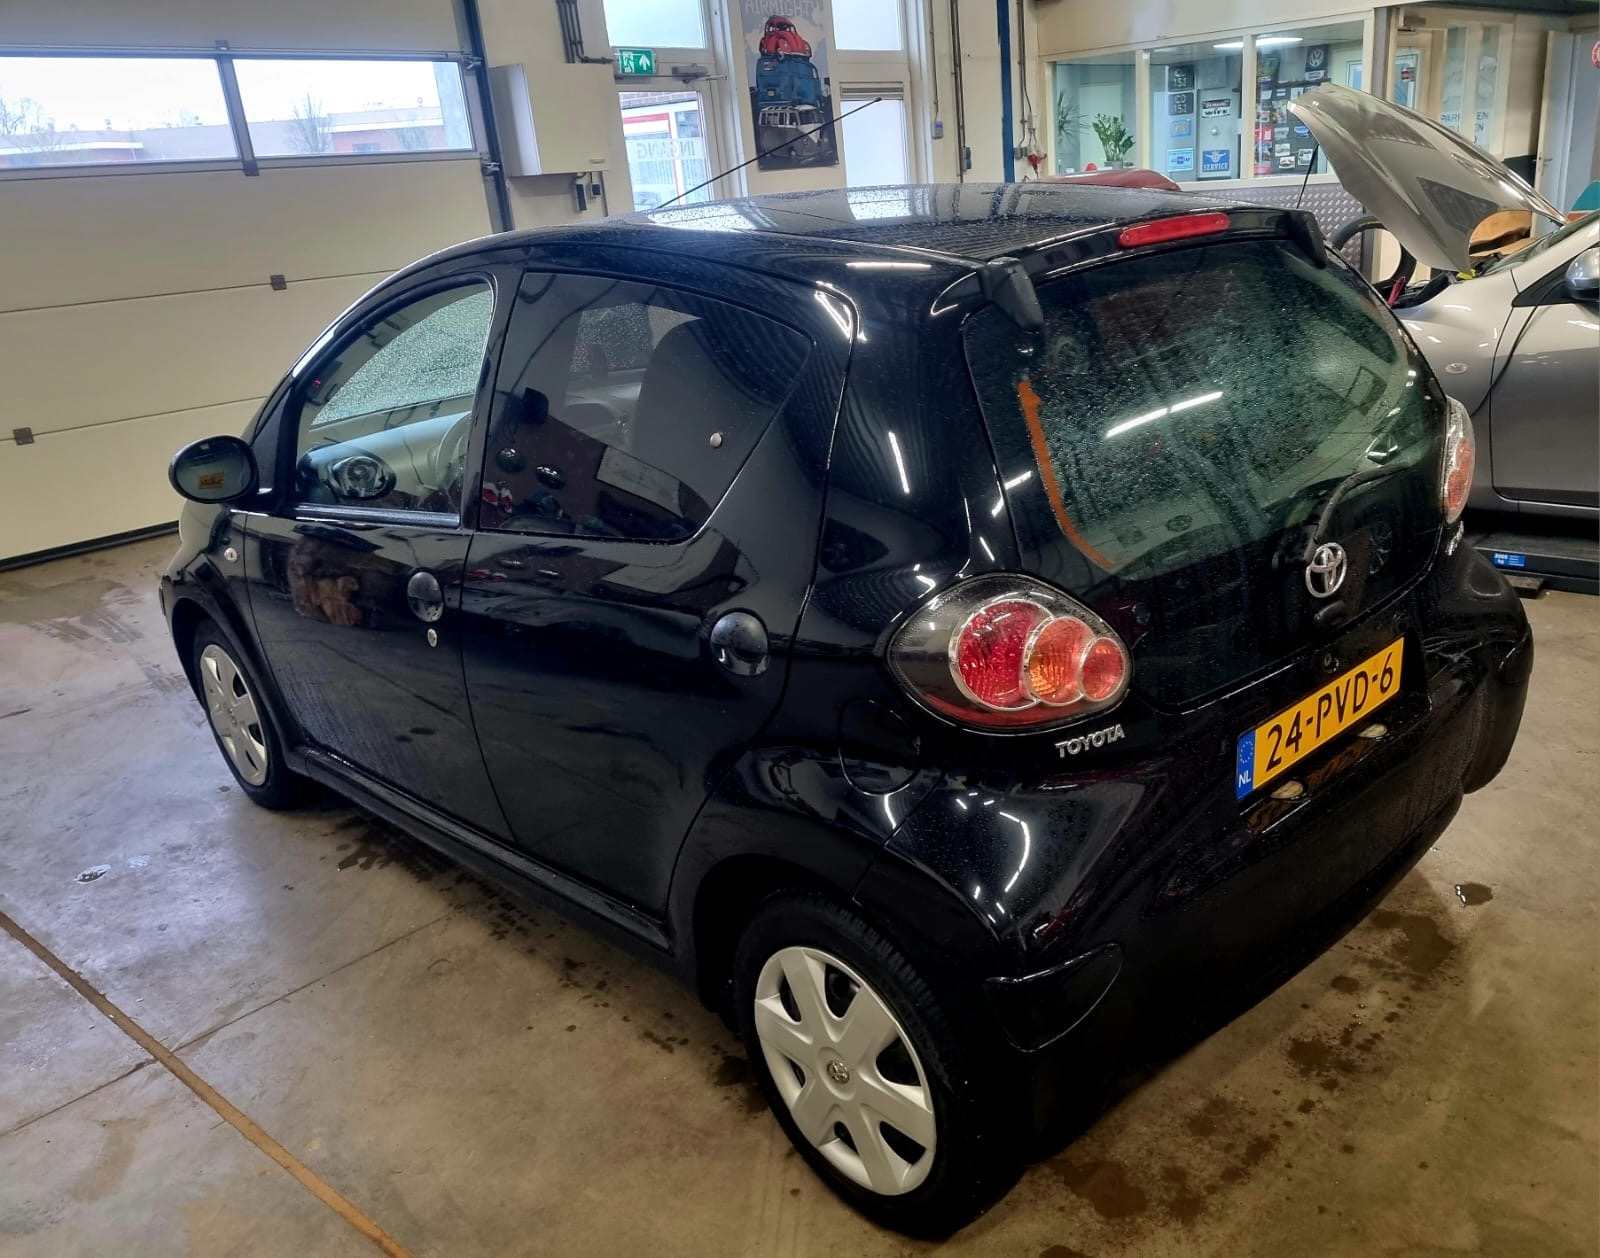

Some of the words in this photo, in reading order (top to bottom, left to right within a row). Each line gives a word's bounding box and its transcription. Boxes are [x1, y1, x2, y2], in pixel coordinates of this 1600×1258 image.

[1203, 162, 1229, 170] SERVICE
[1266, 652, 1394, 772] 24-PVD-6
[1054, 723, 1126, 758] TOYOTA
[1238, 769, 1252, 788] NL
